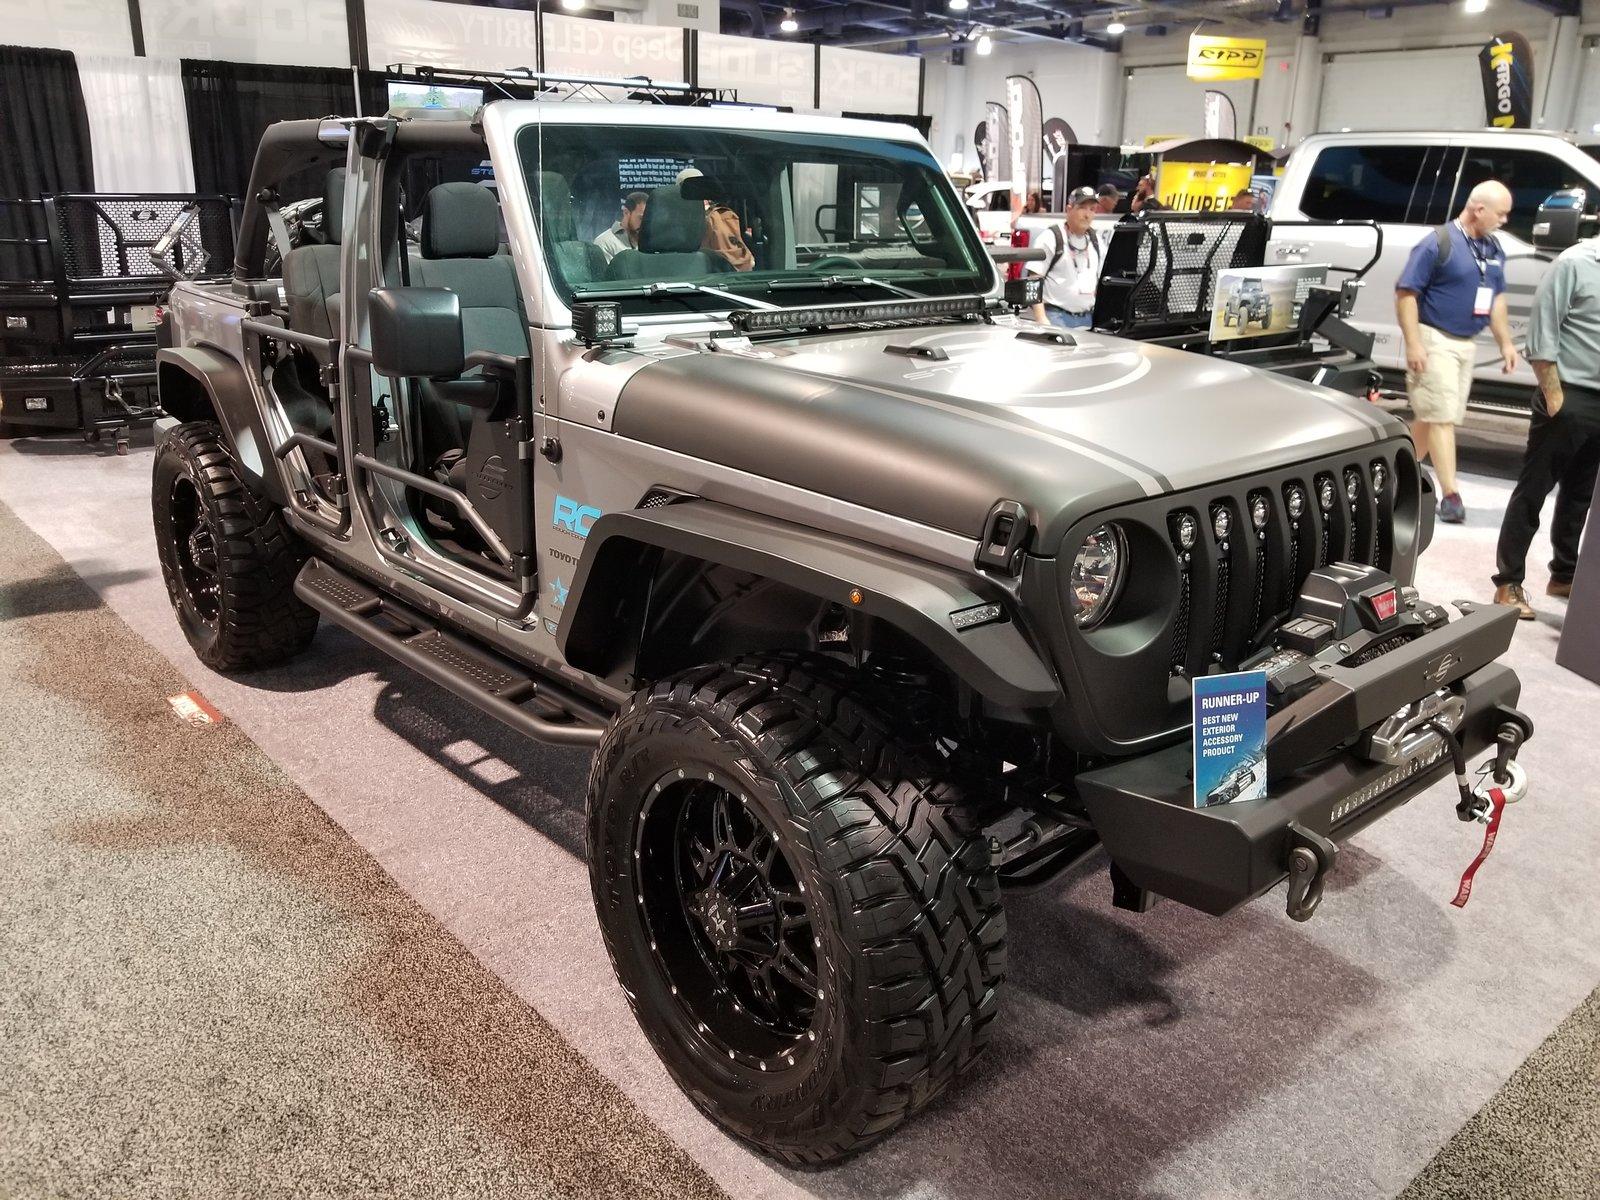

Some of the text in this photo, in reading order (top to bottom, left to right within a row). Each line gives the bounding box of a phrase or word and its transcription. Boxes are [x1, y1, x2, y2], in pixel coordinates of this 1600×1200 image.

[1490, 42, 1512, 114] KARGO
[553, 494, 602, 537] RC
[548, 547, 578, 566] TOYOT
[1202, 692, 1260, 709] RUNNER-UP
[1202, 713, 1239, 725] BEST NEW
[1202, 724, 1236, 736] EXTERIOR
[1202, 734, 1243, 747] ACCESSORY
[1203, 746, 1236, 757] PRODUCT
